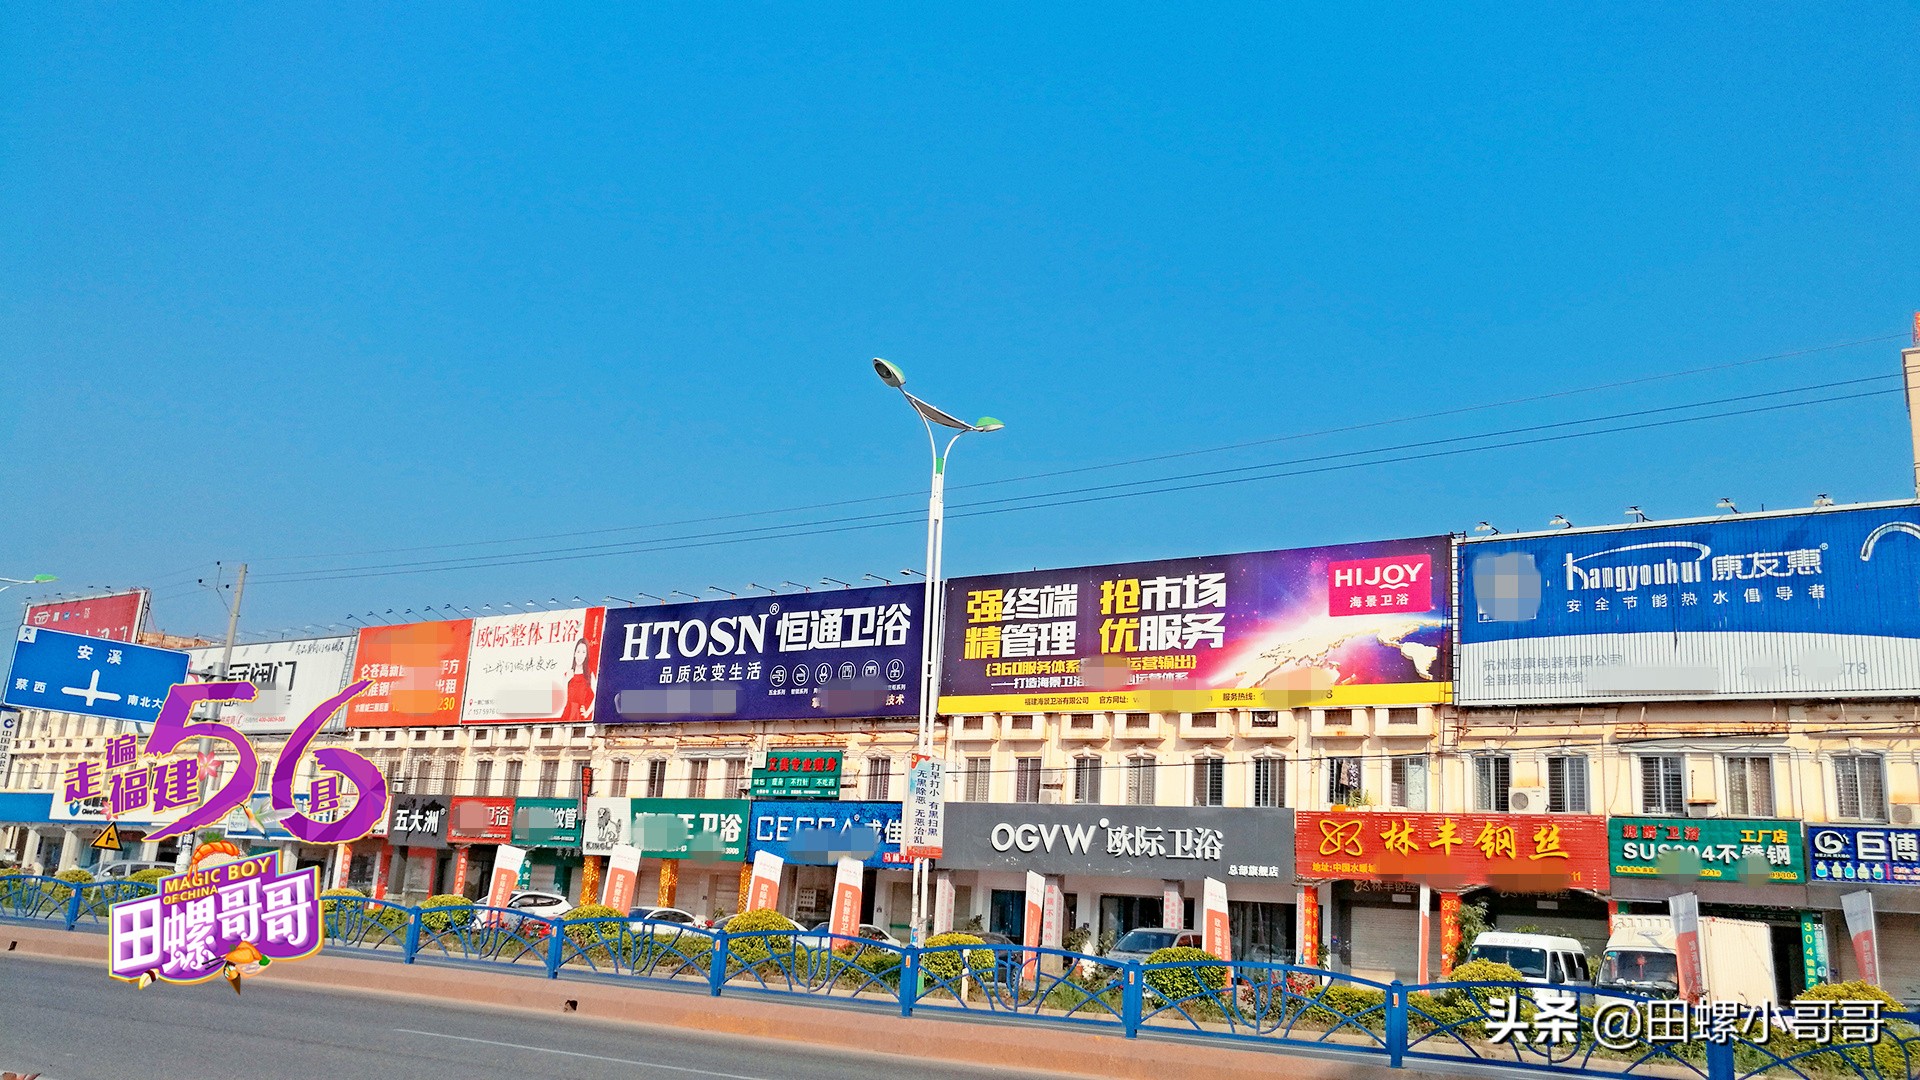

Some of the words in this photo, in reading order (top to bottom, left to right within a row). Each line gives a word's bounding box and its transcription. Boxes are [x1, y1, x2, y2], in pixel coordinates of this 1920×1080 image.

[1334, 562, 1424, 589] HIJOY
[1711, 549, 1823, 581] 康友惠
[965, 582, 1078, 624] 强终端
[1099, 572, 1226, 614] 抢市场
[1349, 594, 1410, 609] 海景卫浴
[1566, 584, 1826, 613] 安全节能热水倡导者
[475, 619, 580, 650] 欧际整体卫浴
[619, 614, 769, 662] HTOSN
[775, 603, 911, 653] 恒通卫浴
[964, 621, 1077, 660] 精管理
[1099, 612, 1225, 654] 优服务
[77, 643, 122, 666] 安溪
[659, 661, 762, 684] 品质改变生活
[393, 808, 439, 834] 五大洲
[927, 801, 939, 837] 有黑扫黑
[990, 822, 1096, 855] OGVW
[1106, 824, 1225, 861] 欧际卫浴
[1380, 817, 1570, 861] 林丰钢丝
[1740, 829, 1788, 844] 工厂店
[1856, 831, 1919, 862] 巨博
[1227, 864, 1280, 879] 总部旗舰店
